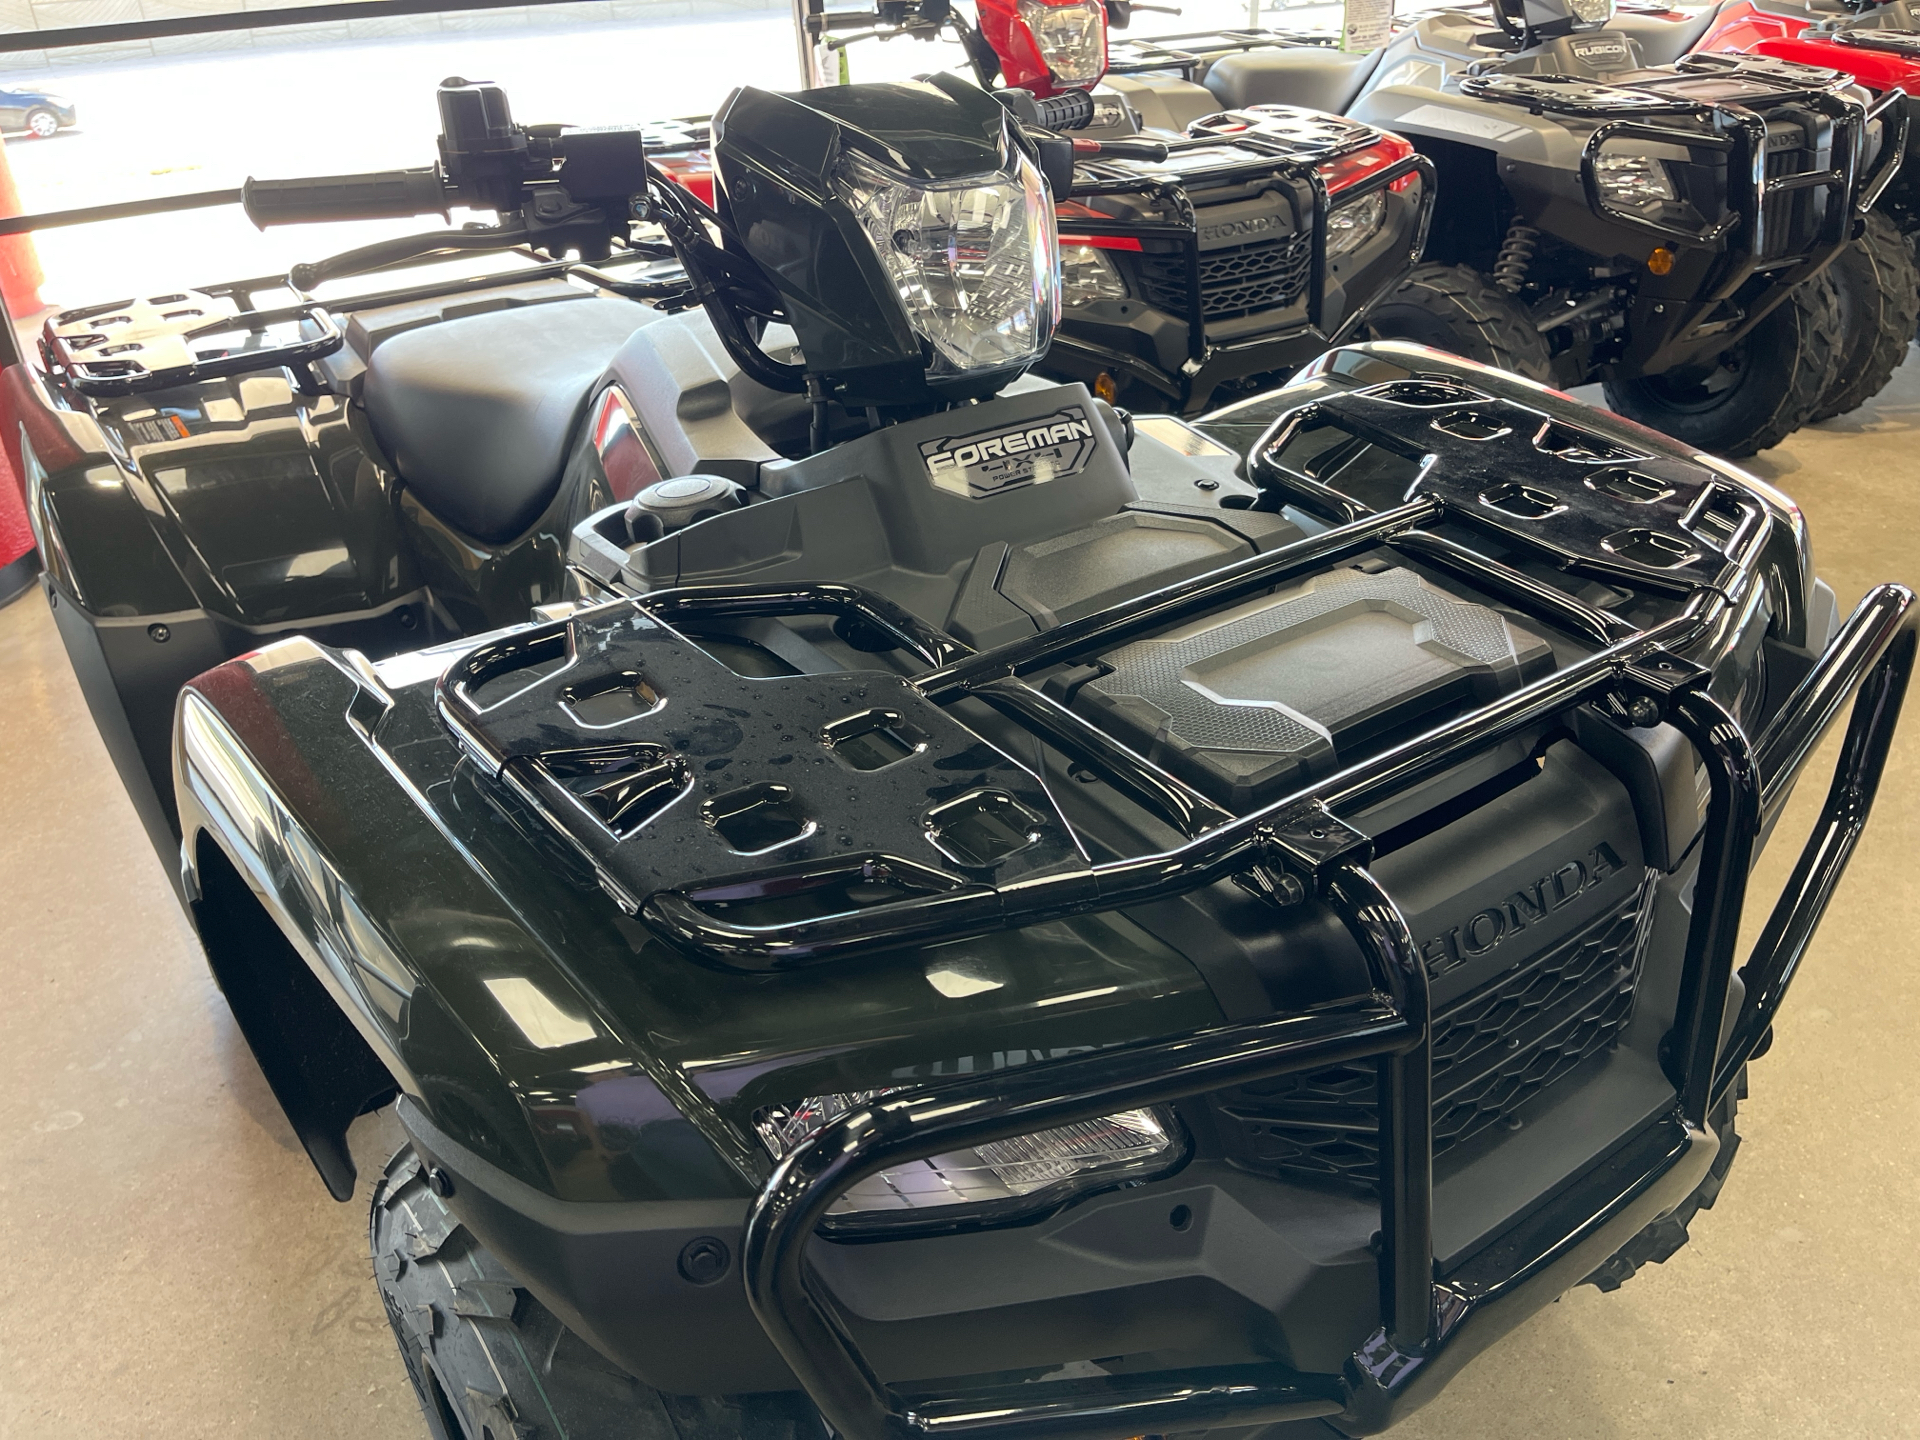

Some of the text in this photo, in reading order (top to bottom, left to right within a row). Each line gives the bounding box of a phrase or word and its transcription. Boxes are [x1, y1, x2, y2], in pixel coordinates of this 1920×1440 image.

[1574, 45, 1627, 57] RUBICON
[1768, 133, 1801, 148] NDA
[1199, 215, 1287, 240] HONDA
[927, 419, 1092, 474] FOREMAN
[992, 470, 1021, 482] POWER
[1421, 841, 1627, 983] HONDA
